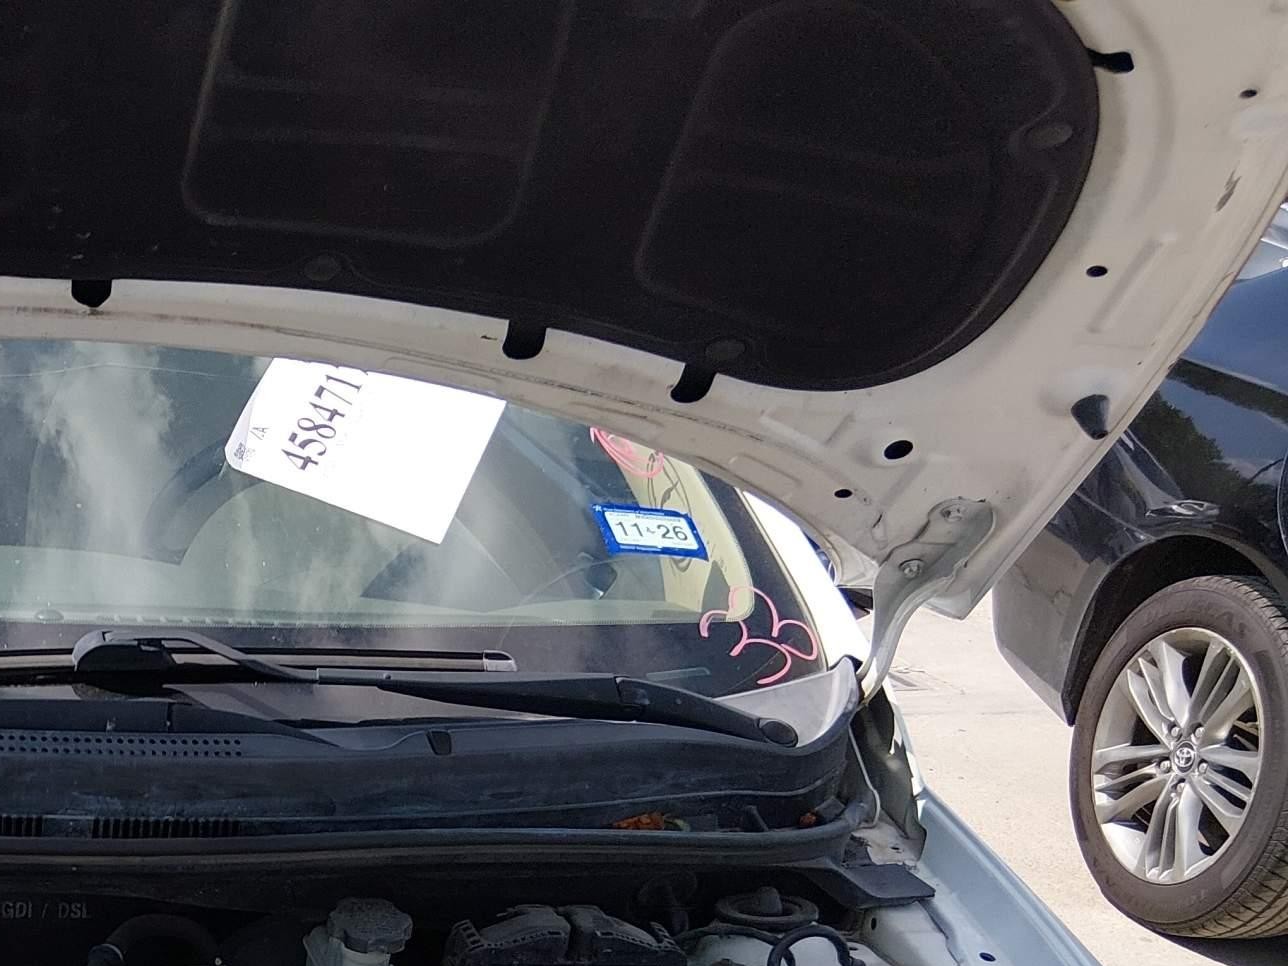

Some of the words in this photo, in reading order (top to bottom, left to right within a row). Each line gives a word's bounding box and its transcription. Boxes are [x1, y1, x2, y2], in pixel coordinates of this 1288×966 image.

[280, 372, 368, 471] 458471
[656, 524, 689, 542] 26
[1, 900, 33, 919] GDI
[57, 901, 92, 919] DSL
